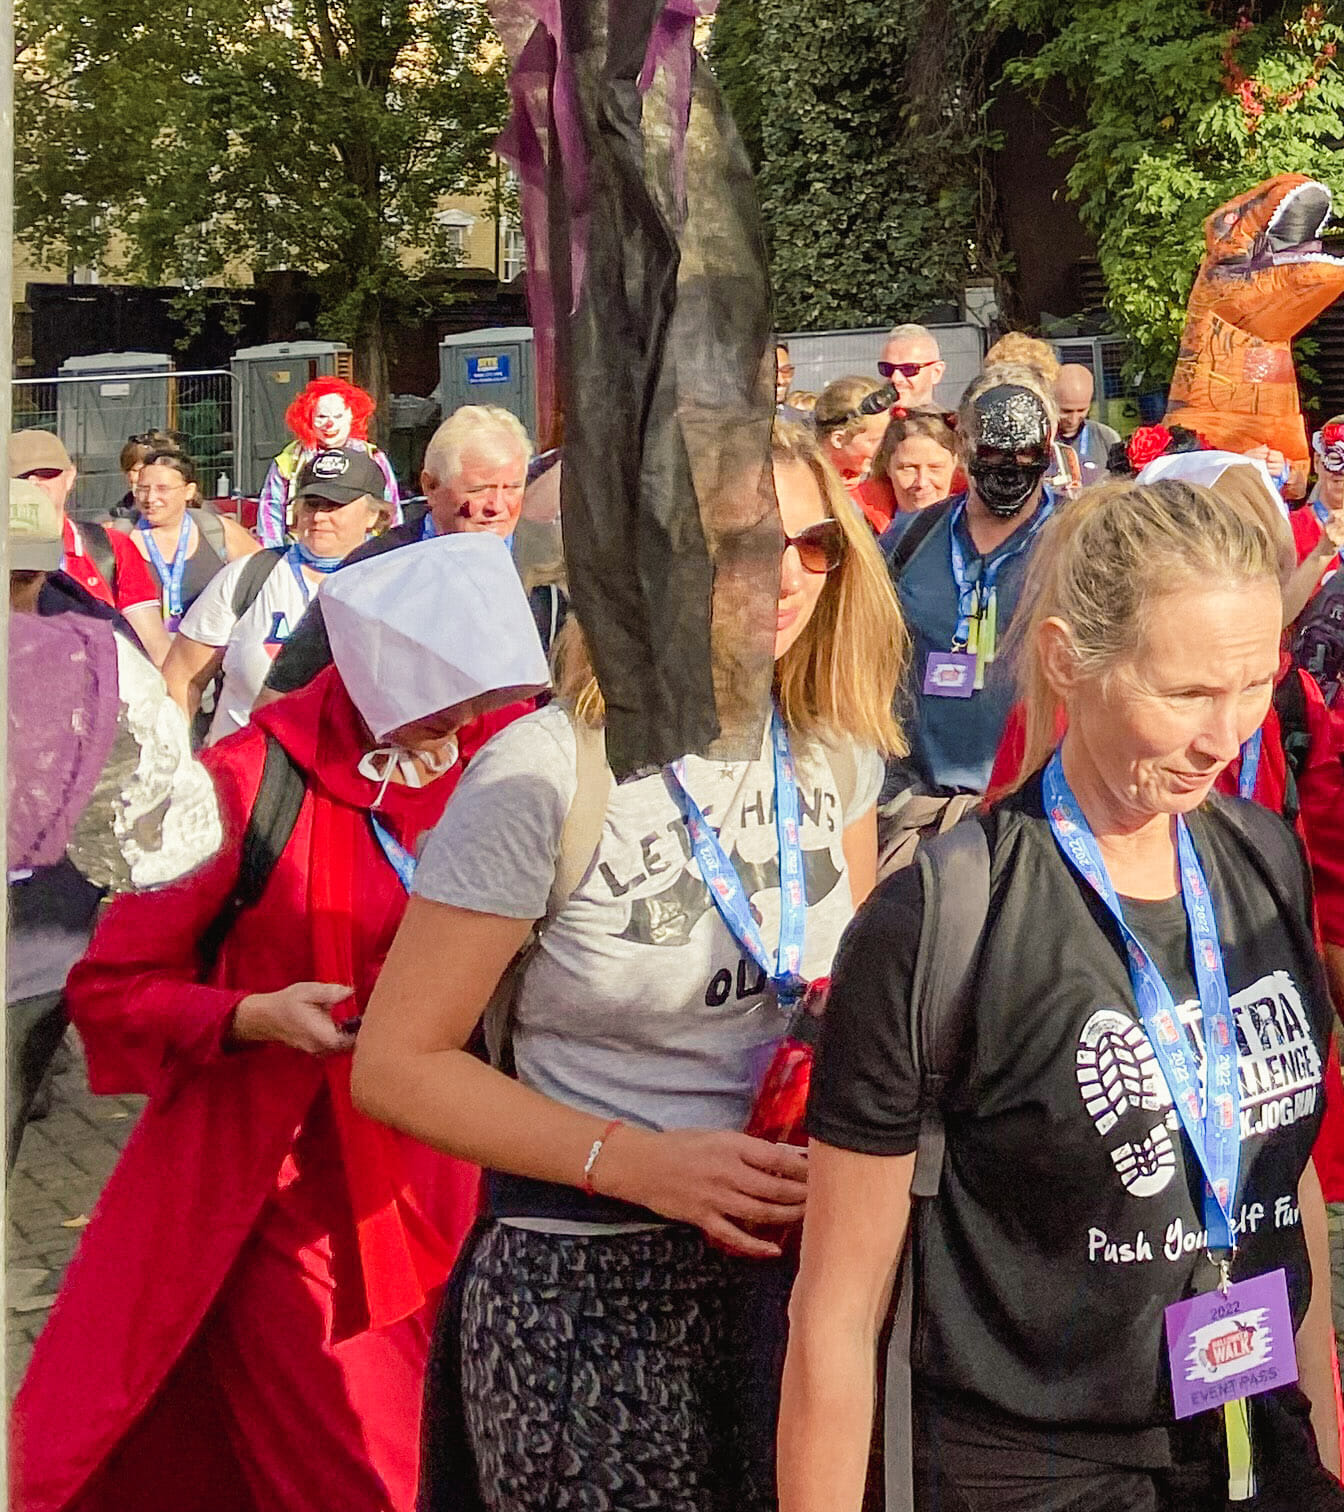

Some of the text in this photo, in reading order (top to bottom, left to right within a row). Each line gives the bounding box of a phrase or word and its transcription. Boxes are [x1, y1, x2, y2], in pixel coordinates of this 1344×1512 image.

[1087, 1226, 1153, 1263] Push
[1211, 1300, 1241, 1321] 2022
[1213, 1338, 1252, 1364] WALK
[1190, 1366, 1279, 1406] EVENT PASS
